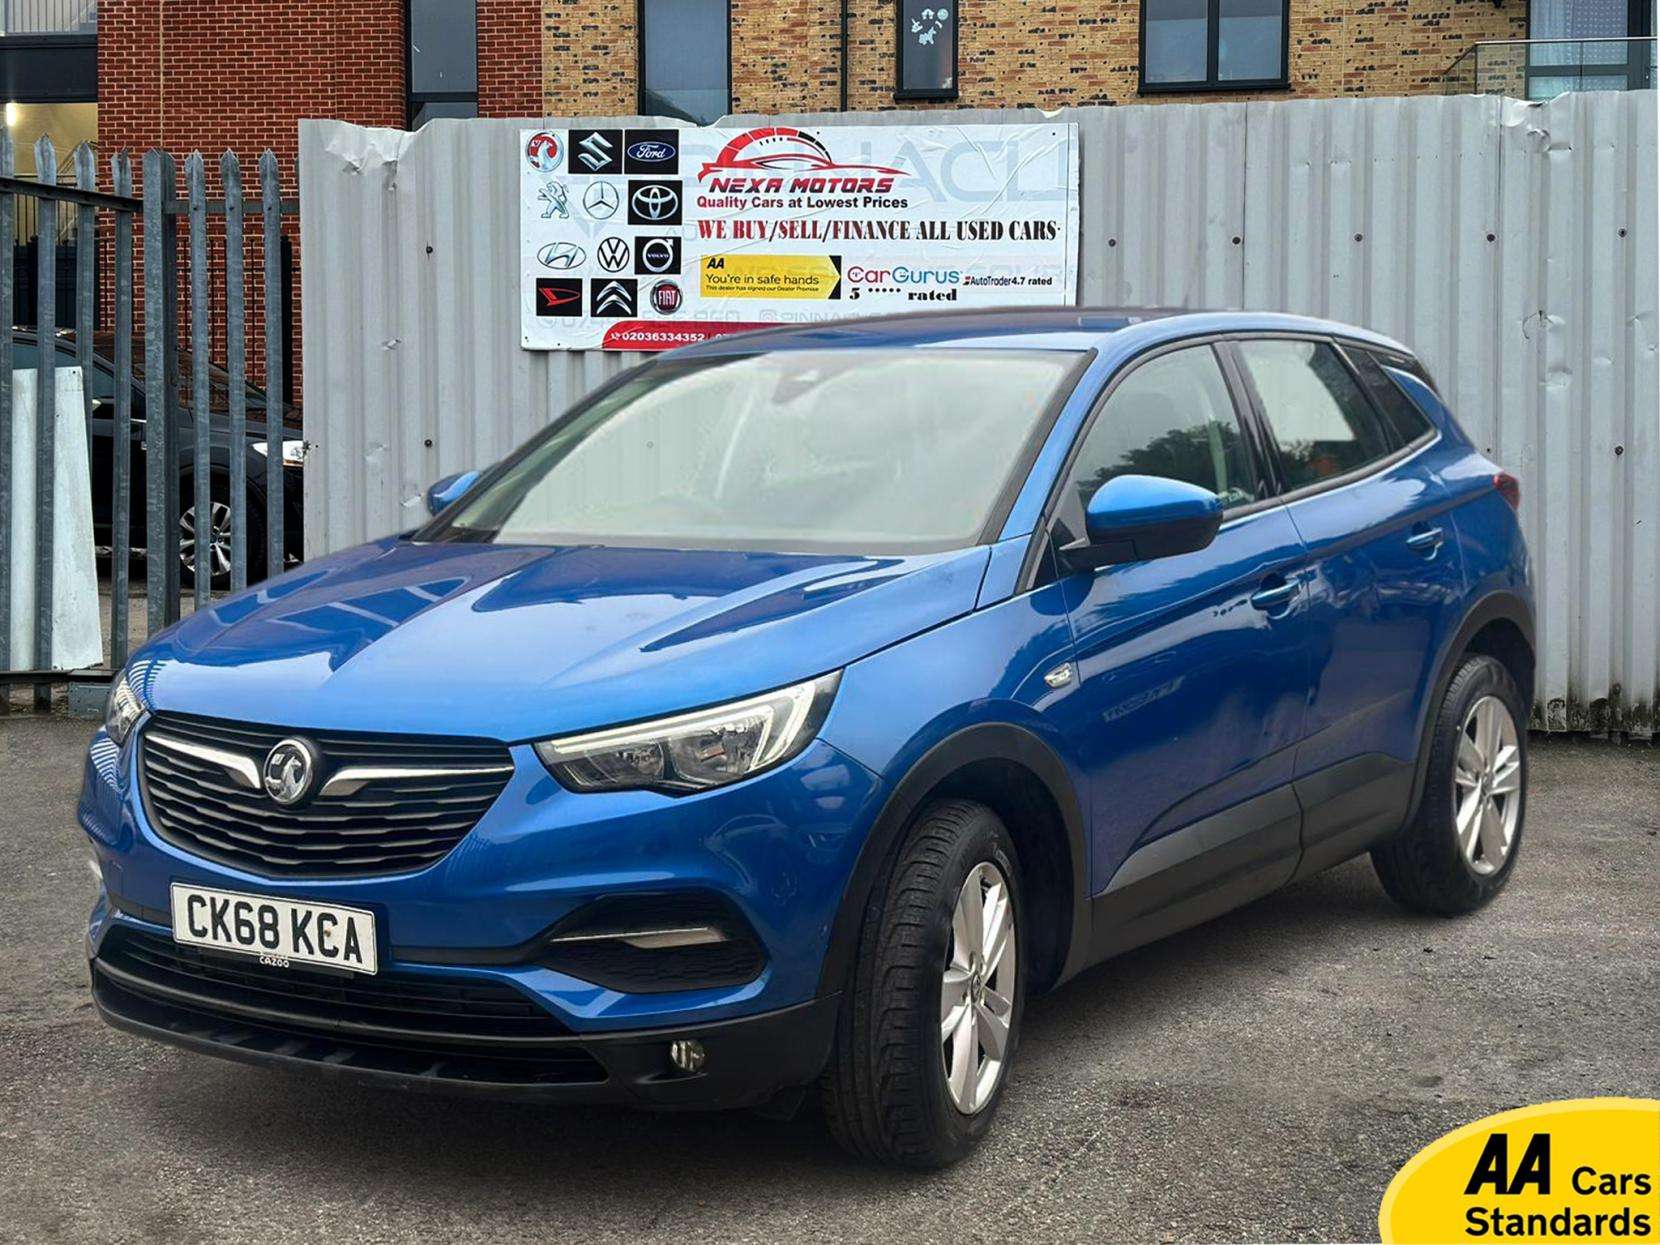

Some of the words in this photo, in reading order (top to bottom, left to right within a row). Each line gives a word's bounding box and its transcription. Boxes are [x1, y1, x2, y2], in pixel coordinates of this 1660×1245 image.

[636, 143, 666, 158] Ford
[709, 178, 784, 193] NEXA
[789, 178, 894, 193] MOTORS
[697, 196, 747, 210] Quality
[752, 197, 784, 208] Cars
[788, 197, 802, 208] at
[807, 197, 859, 208] Lowest
[863, 196, 908, 208] Prices
[697, 219, 728, 240] WE
[916, 221, 951, 240] ALL
[957, 220, 1004, 240] USED
[1008, 220, 1057, 240] CARS
[706, 257, 725, 269] AA
[706, 273, 741, 284] You're
[744, 273, 754, 284] in
[757, 274, 781, 285] safe
[784, 274, 820, 285] hands
[1028, 277, 1053, 286] rated
[658, 290, 676, 305] FIAT
[849, 287, 860, 300] 5
[908, 289, 957, 301] rated
[622, 332, 706, 342] 02036334352
[187, 893, 280, 950] CK68
[290, 908, 363, 965] KCA
